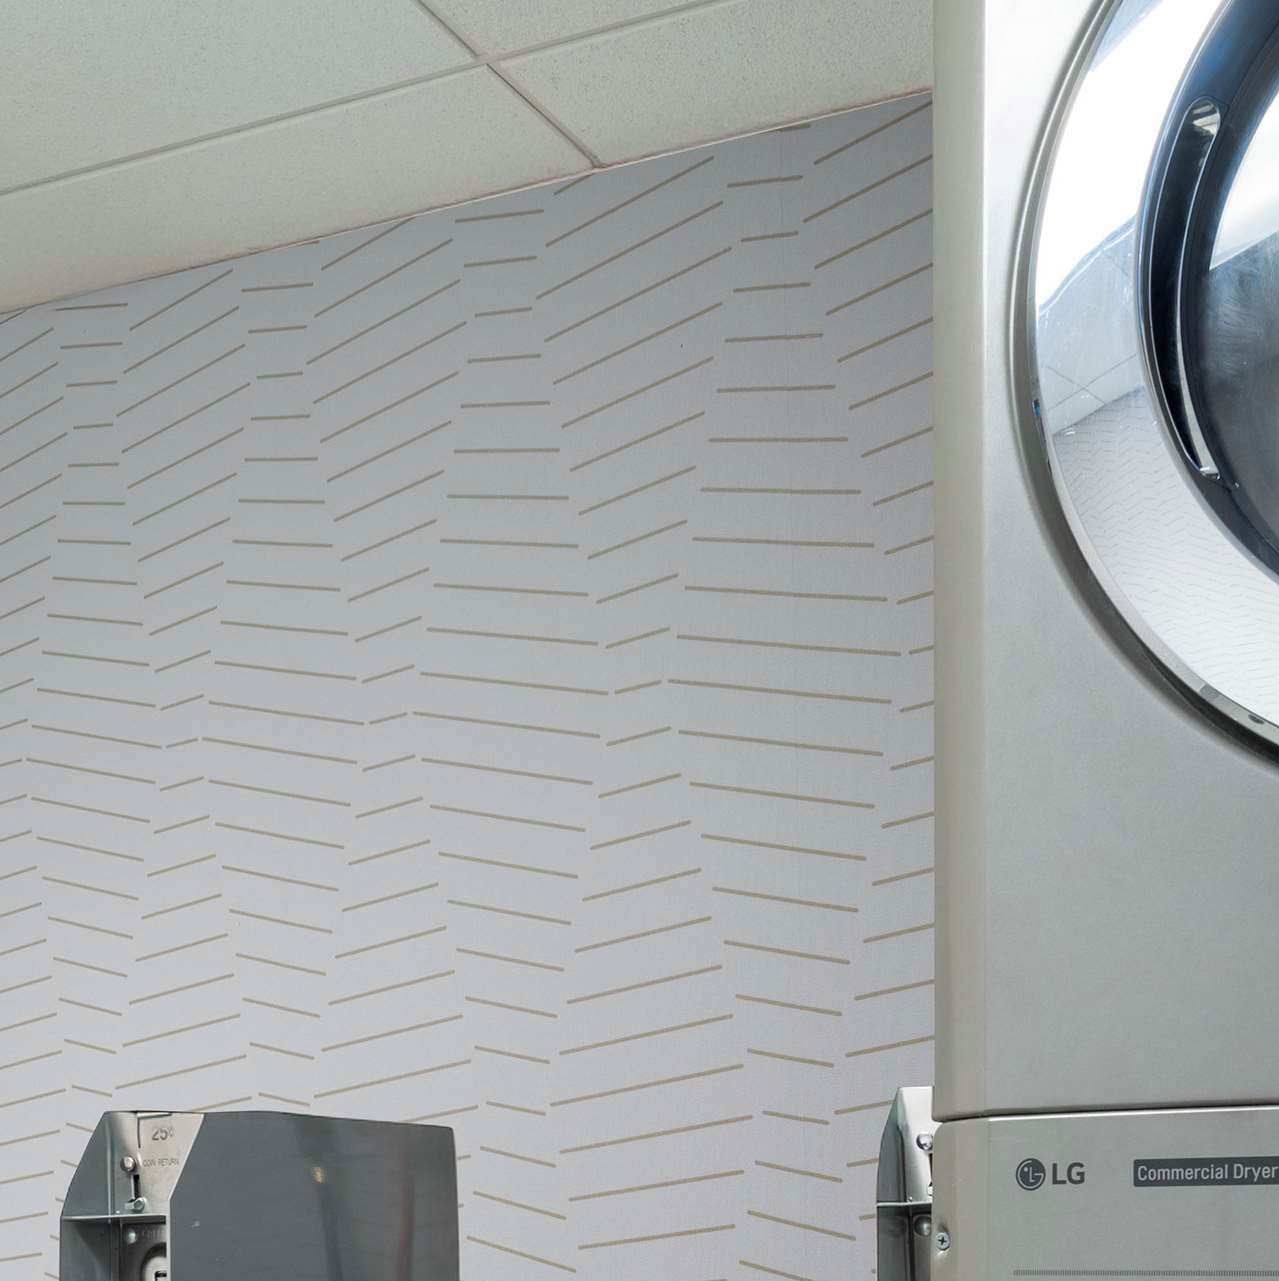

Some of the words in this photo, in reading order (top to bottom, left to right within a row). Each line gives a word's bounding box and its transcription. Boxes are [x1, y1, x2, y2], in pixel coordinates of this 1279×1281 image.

[1052, 1163, 1085, 1185] LG
[1137, 1164, 1228, 1182] Commercial
[1233, 1163, 1279, 1183] Dryer
